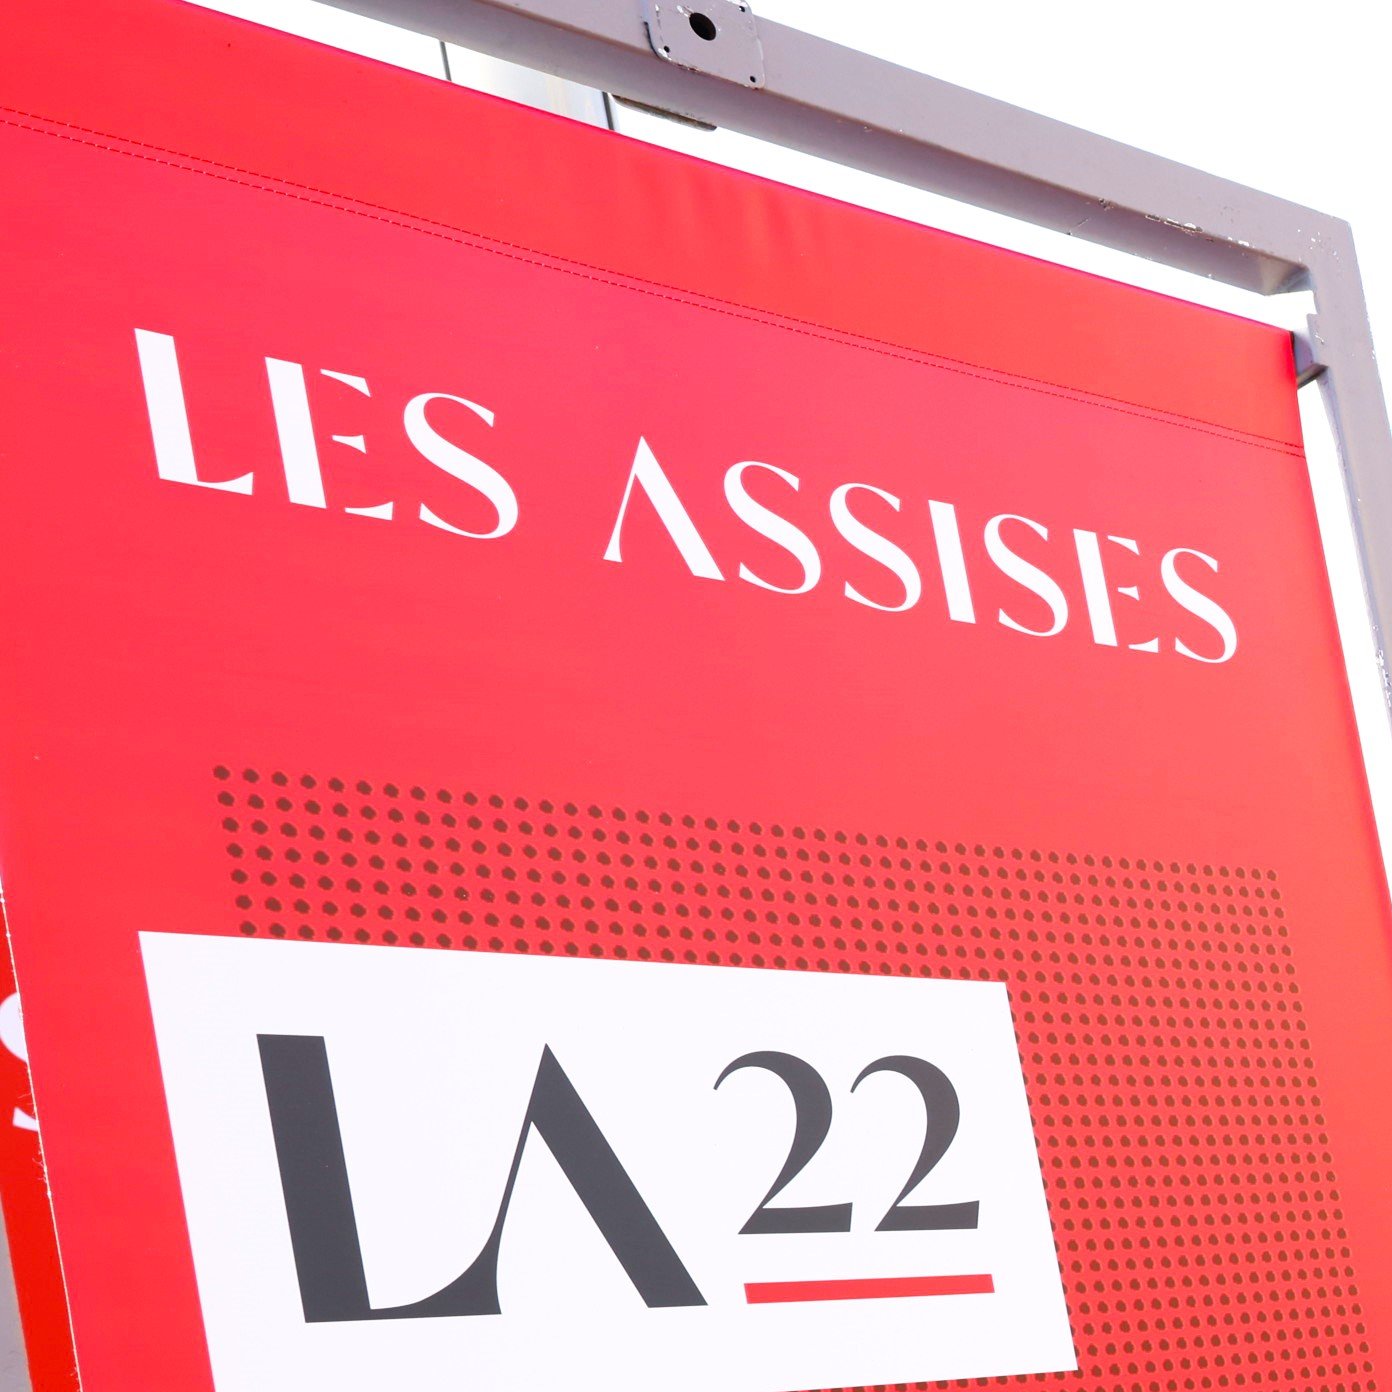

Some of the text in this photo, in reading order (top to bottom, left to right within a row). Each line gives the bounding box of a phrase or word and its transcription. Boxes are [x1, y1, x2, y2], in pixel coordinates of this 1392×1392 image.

[134, 326, 1239, 665] LES ASSISES
[256, 1033, 980, 1324] LA22
